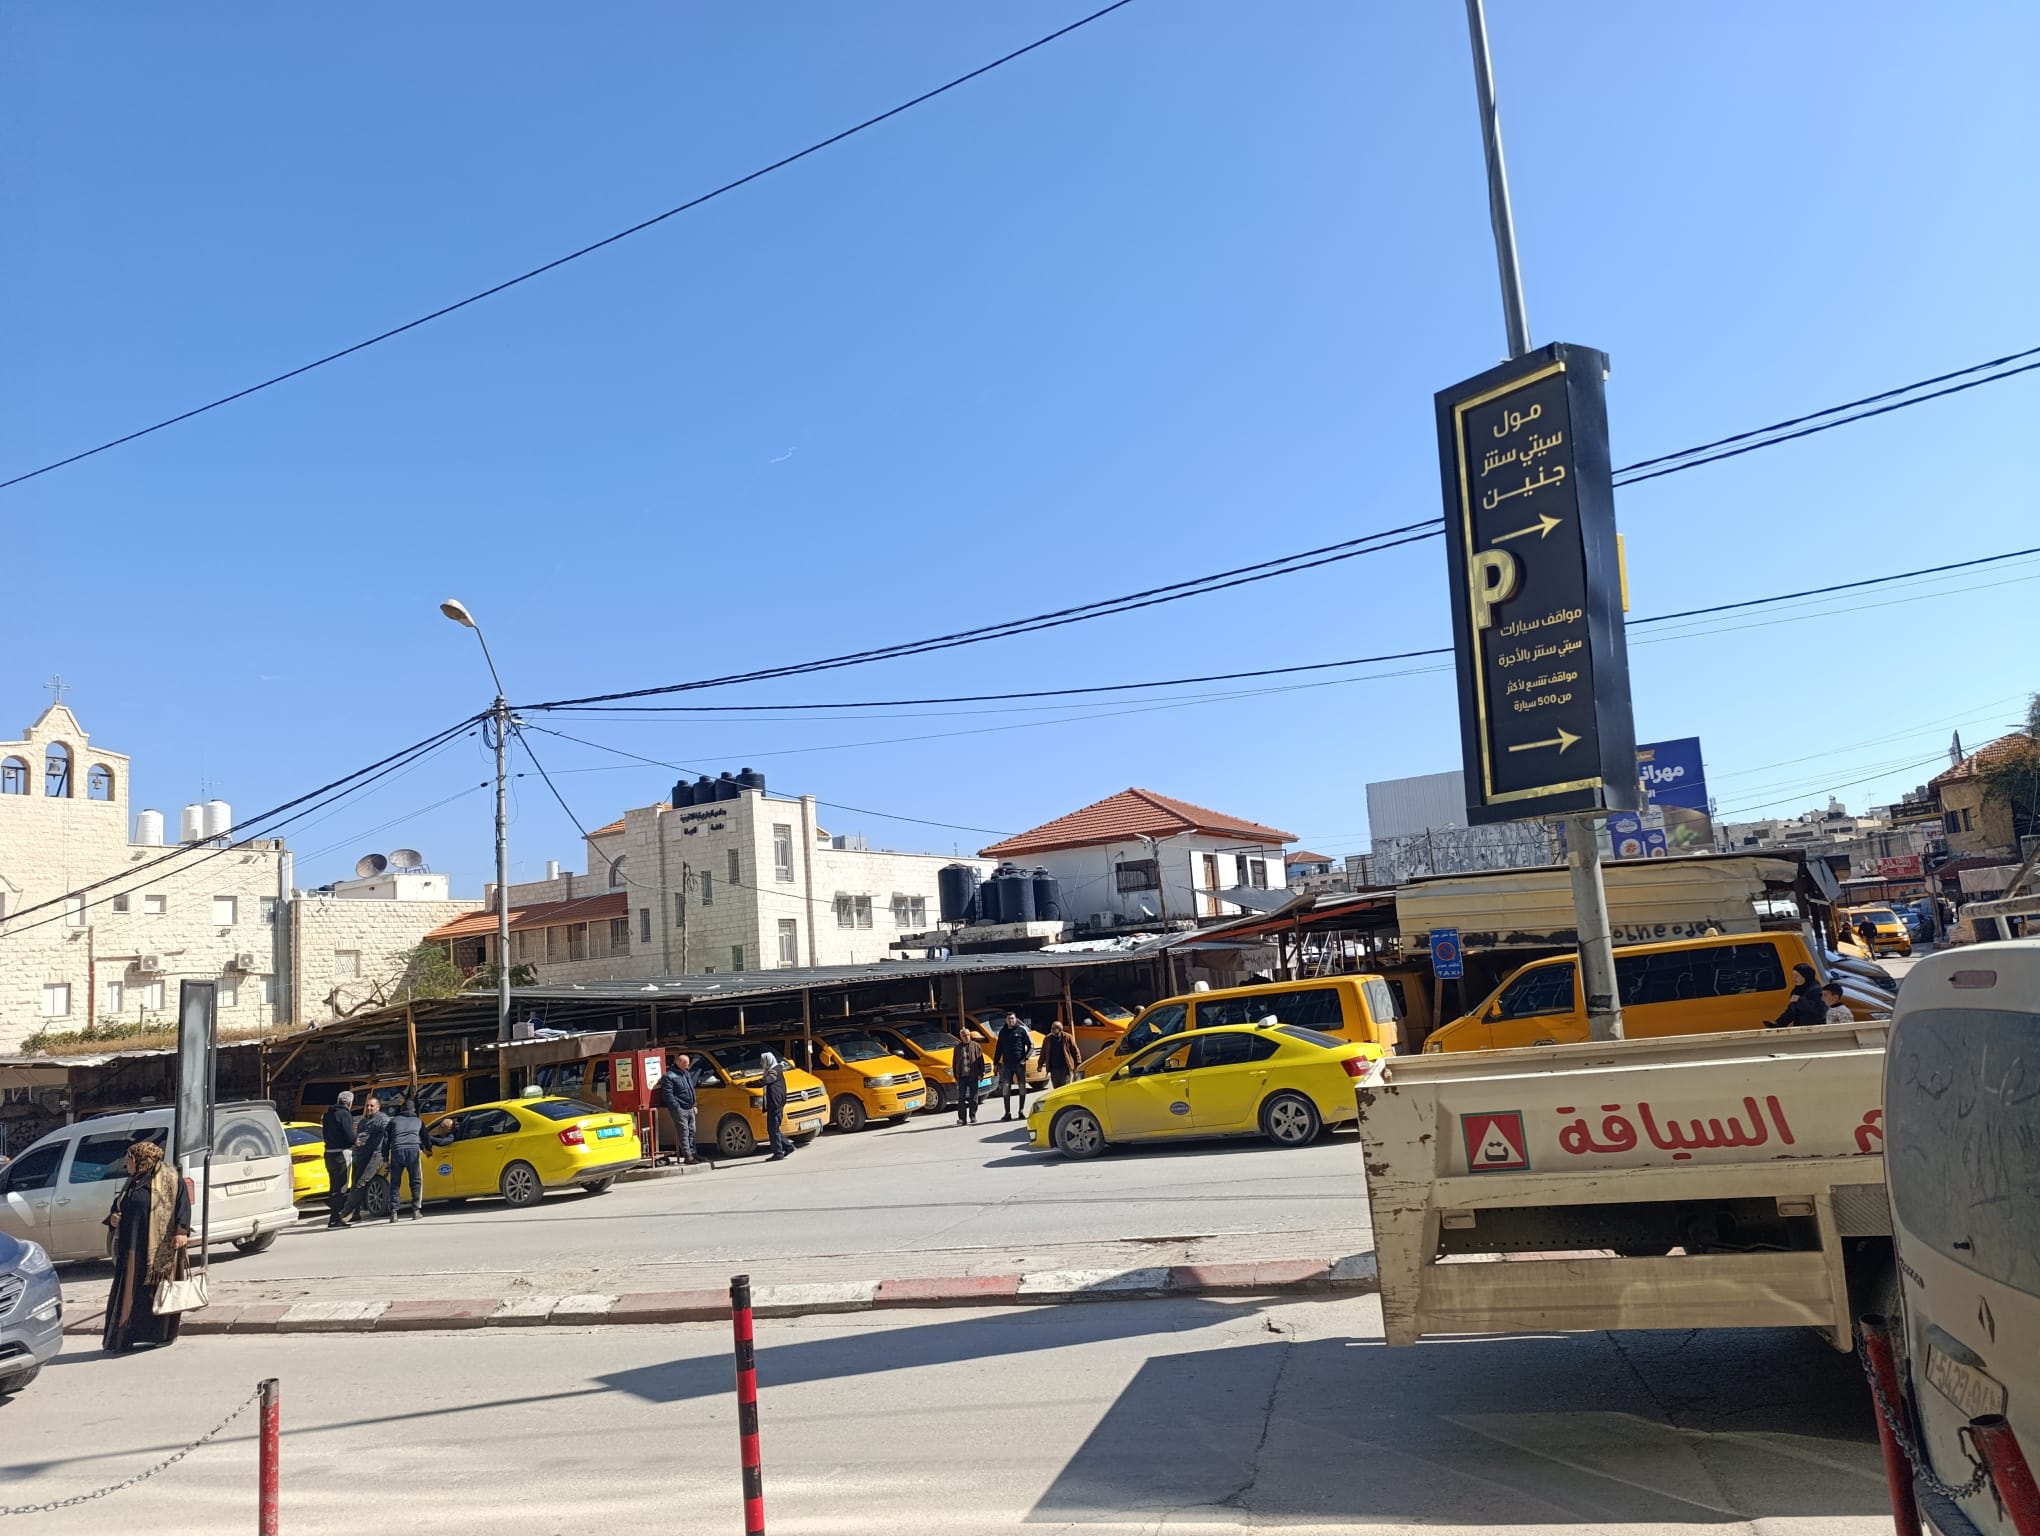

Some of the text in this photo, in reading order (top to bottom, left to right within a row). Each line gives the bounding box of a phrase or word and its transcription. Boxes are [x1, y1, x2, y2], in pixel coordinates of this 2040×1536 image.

[1493, 404, 1542, 438] مول
[1481, 431, 1563, 477] سيتي سنتر
[1483, 465, 1566, 510] جنين
[1472, 548, 1515, 629] P
[1500, 608, 1582, 637] مواقف سيارات
[1498, 639, 1582, 668] سيتي سنتر بالأجرة
[1506, 671, 1578, 695] مواقف تتسع لأكثر
[1514, 693, 1572, 712] من 500 سيارة
[1638, 764, 1685, 784] مهران
[1558, 1095, 1795, 1160] السياقة
